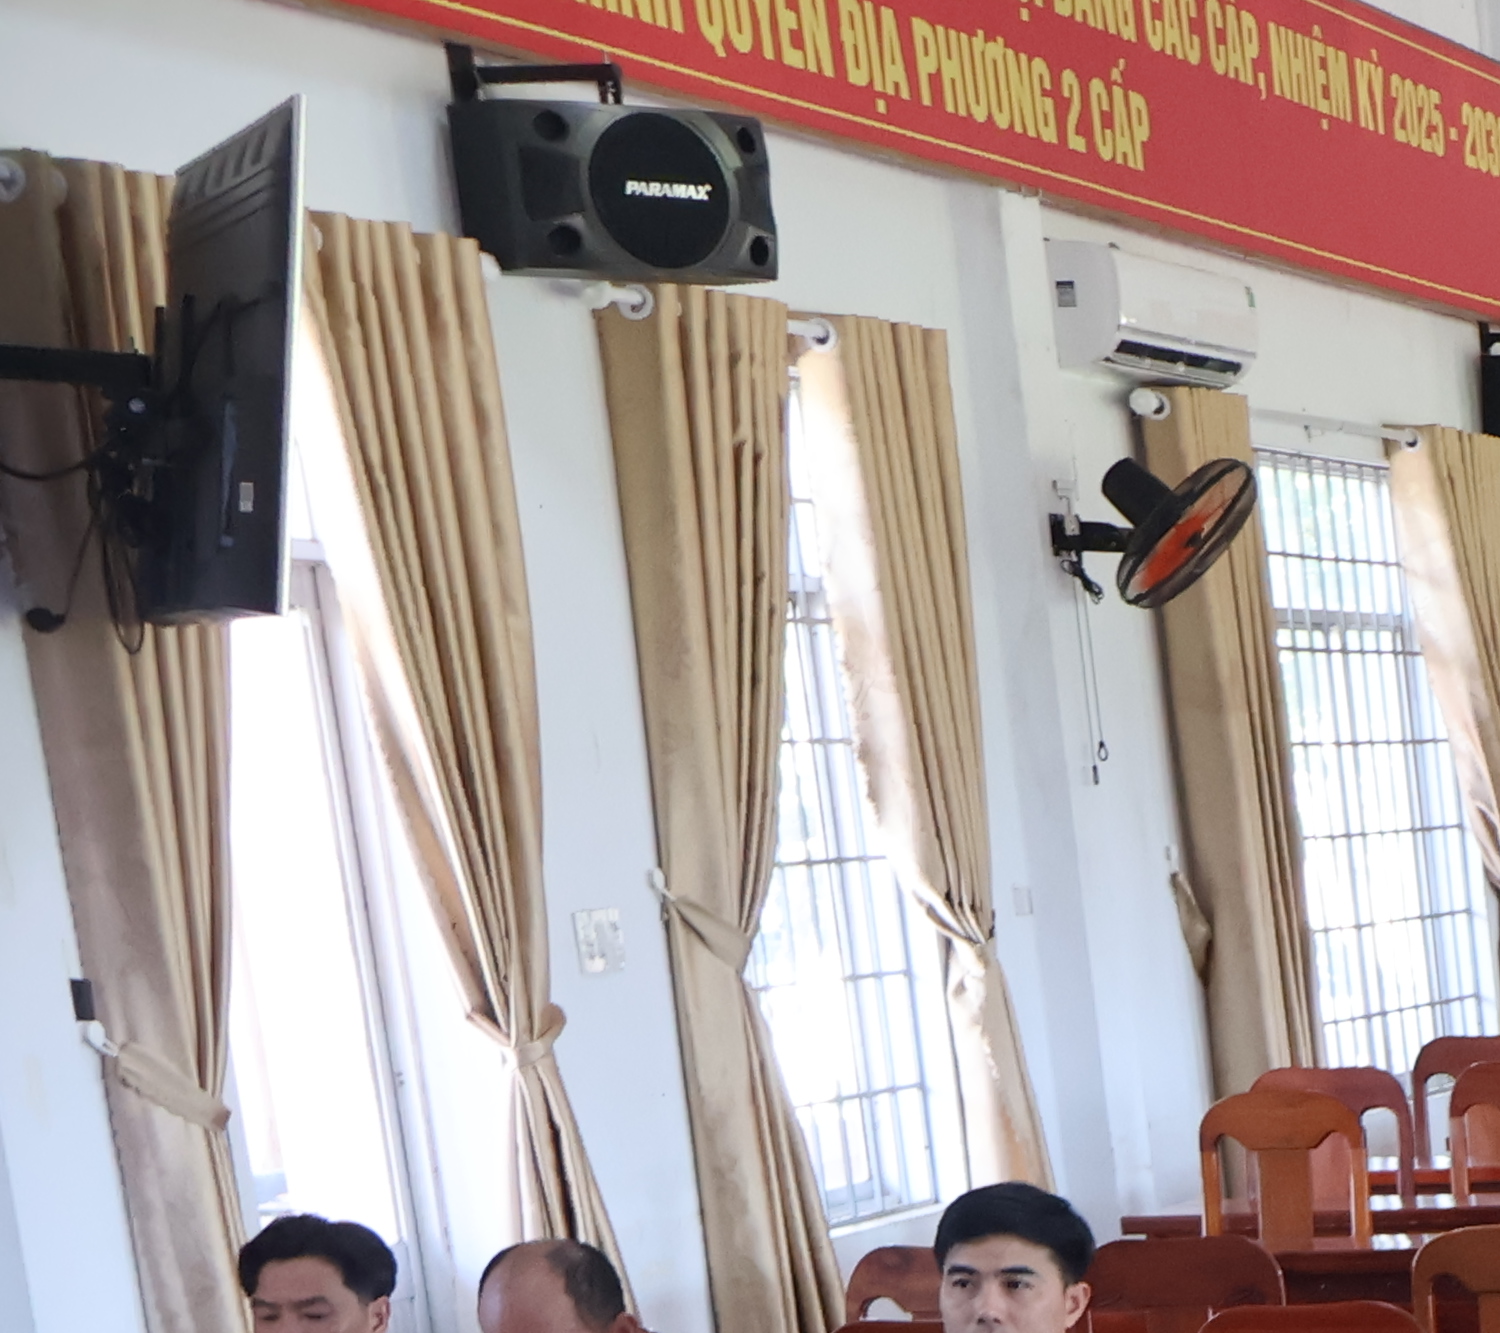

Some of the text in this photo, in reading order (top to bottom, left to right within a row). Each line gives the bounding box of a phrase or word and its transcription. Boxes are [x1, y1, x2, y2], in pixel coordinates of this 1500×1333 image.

[839, 0, 911, 114] ĐỊA
[911, 17, 1058, 144] PHƯƠNG
[1061, 69, 1087, 153] 2
[1089, 58, 1150, 170] CẤP
[1268, 22, 1352, 130] NHIỆM
[1354, 48, 1385, 134] KỲ
[1390, 73, 1445, 156] 2025
[624, 179, 712, 201] PARAMAX
